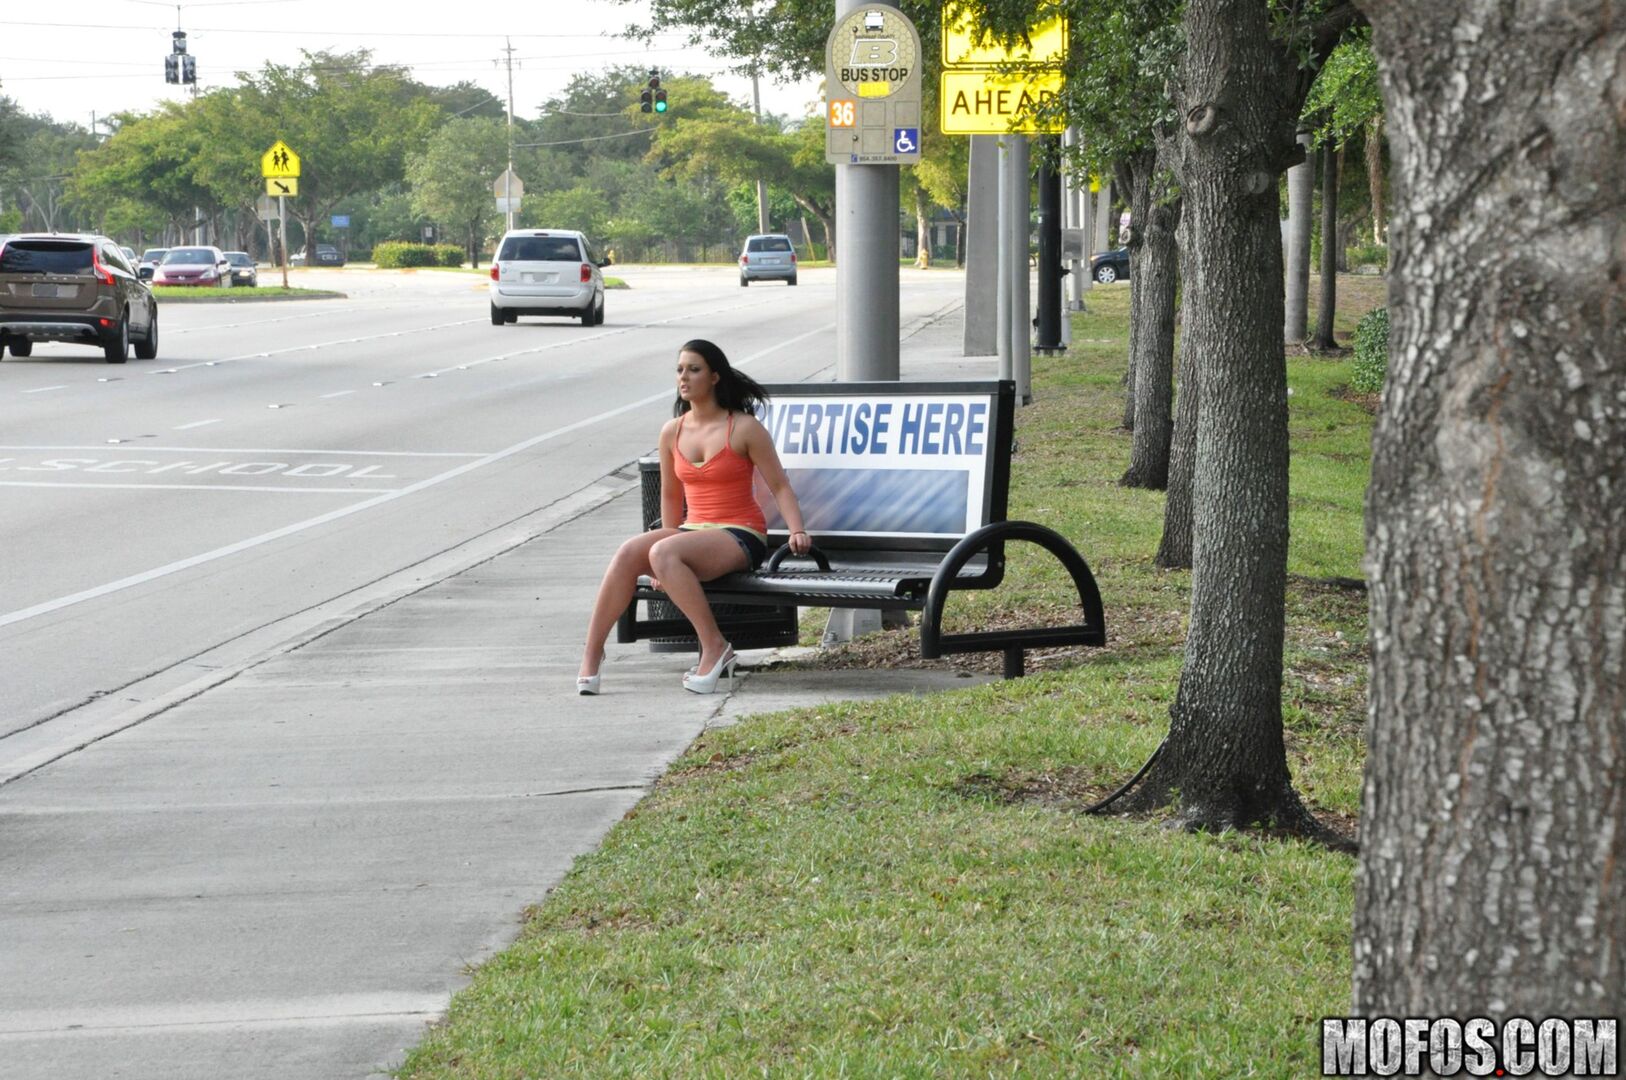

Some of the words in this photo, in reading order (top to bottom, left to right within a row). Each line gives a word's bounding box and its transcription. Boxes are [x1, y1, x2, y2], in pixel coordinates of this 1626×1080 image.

[841, 67, 868, 82] BUS
[871, 67, 908, 82] STOP
[831, 101, 854, 126] 36
[753, 403, 893, 455] VERTISE
[898, 403, 987, 456] HERE
[16, 457, 397, 479] SCHOOL
